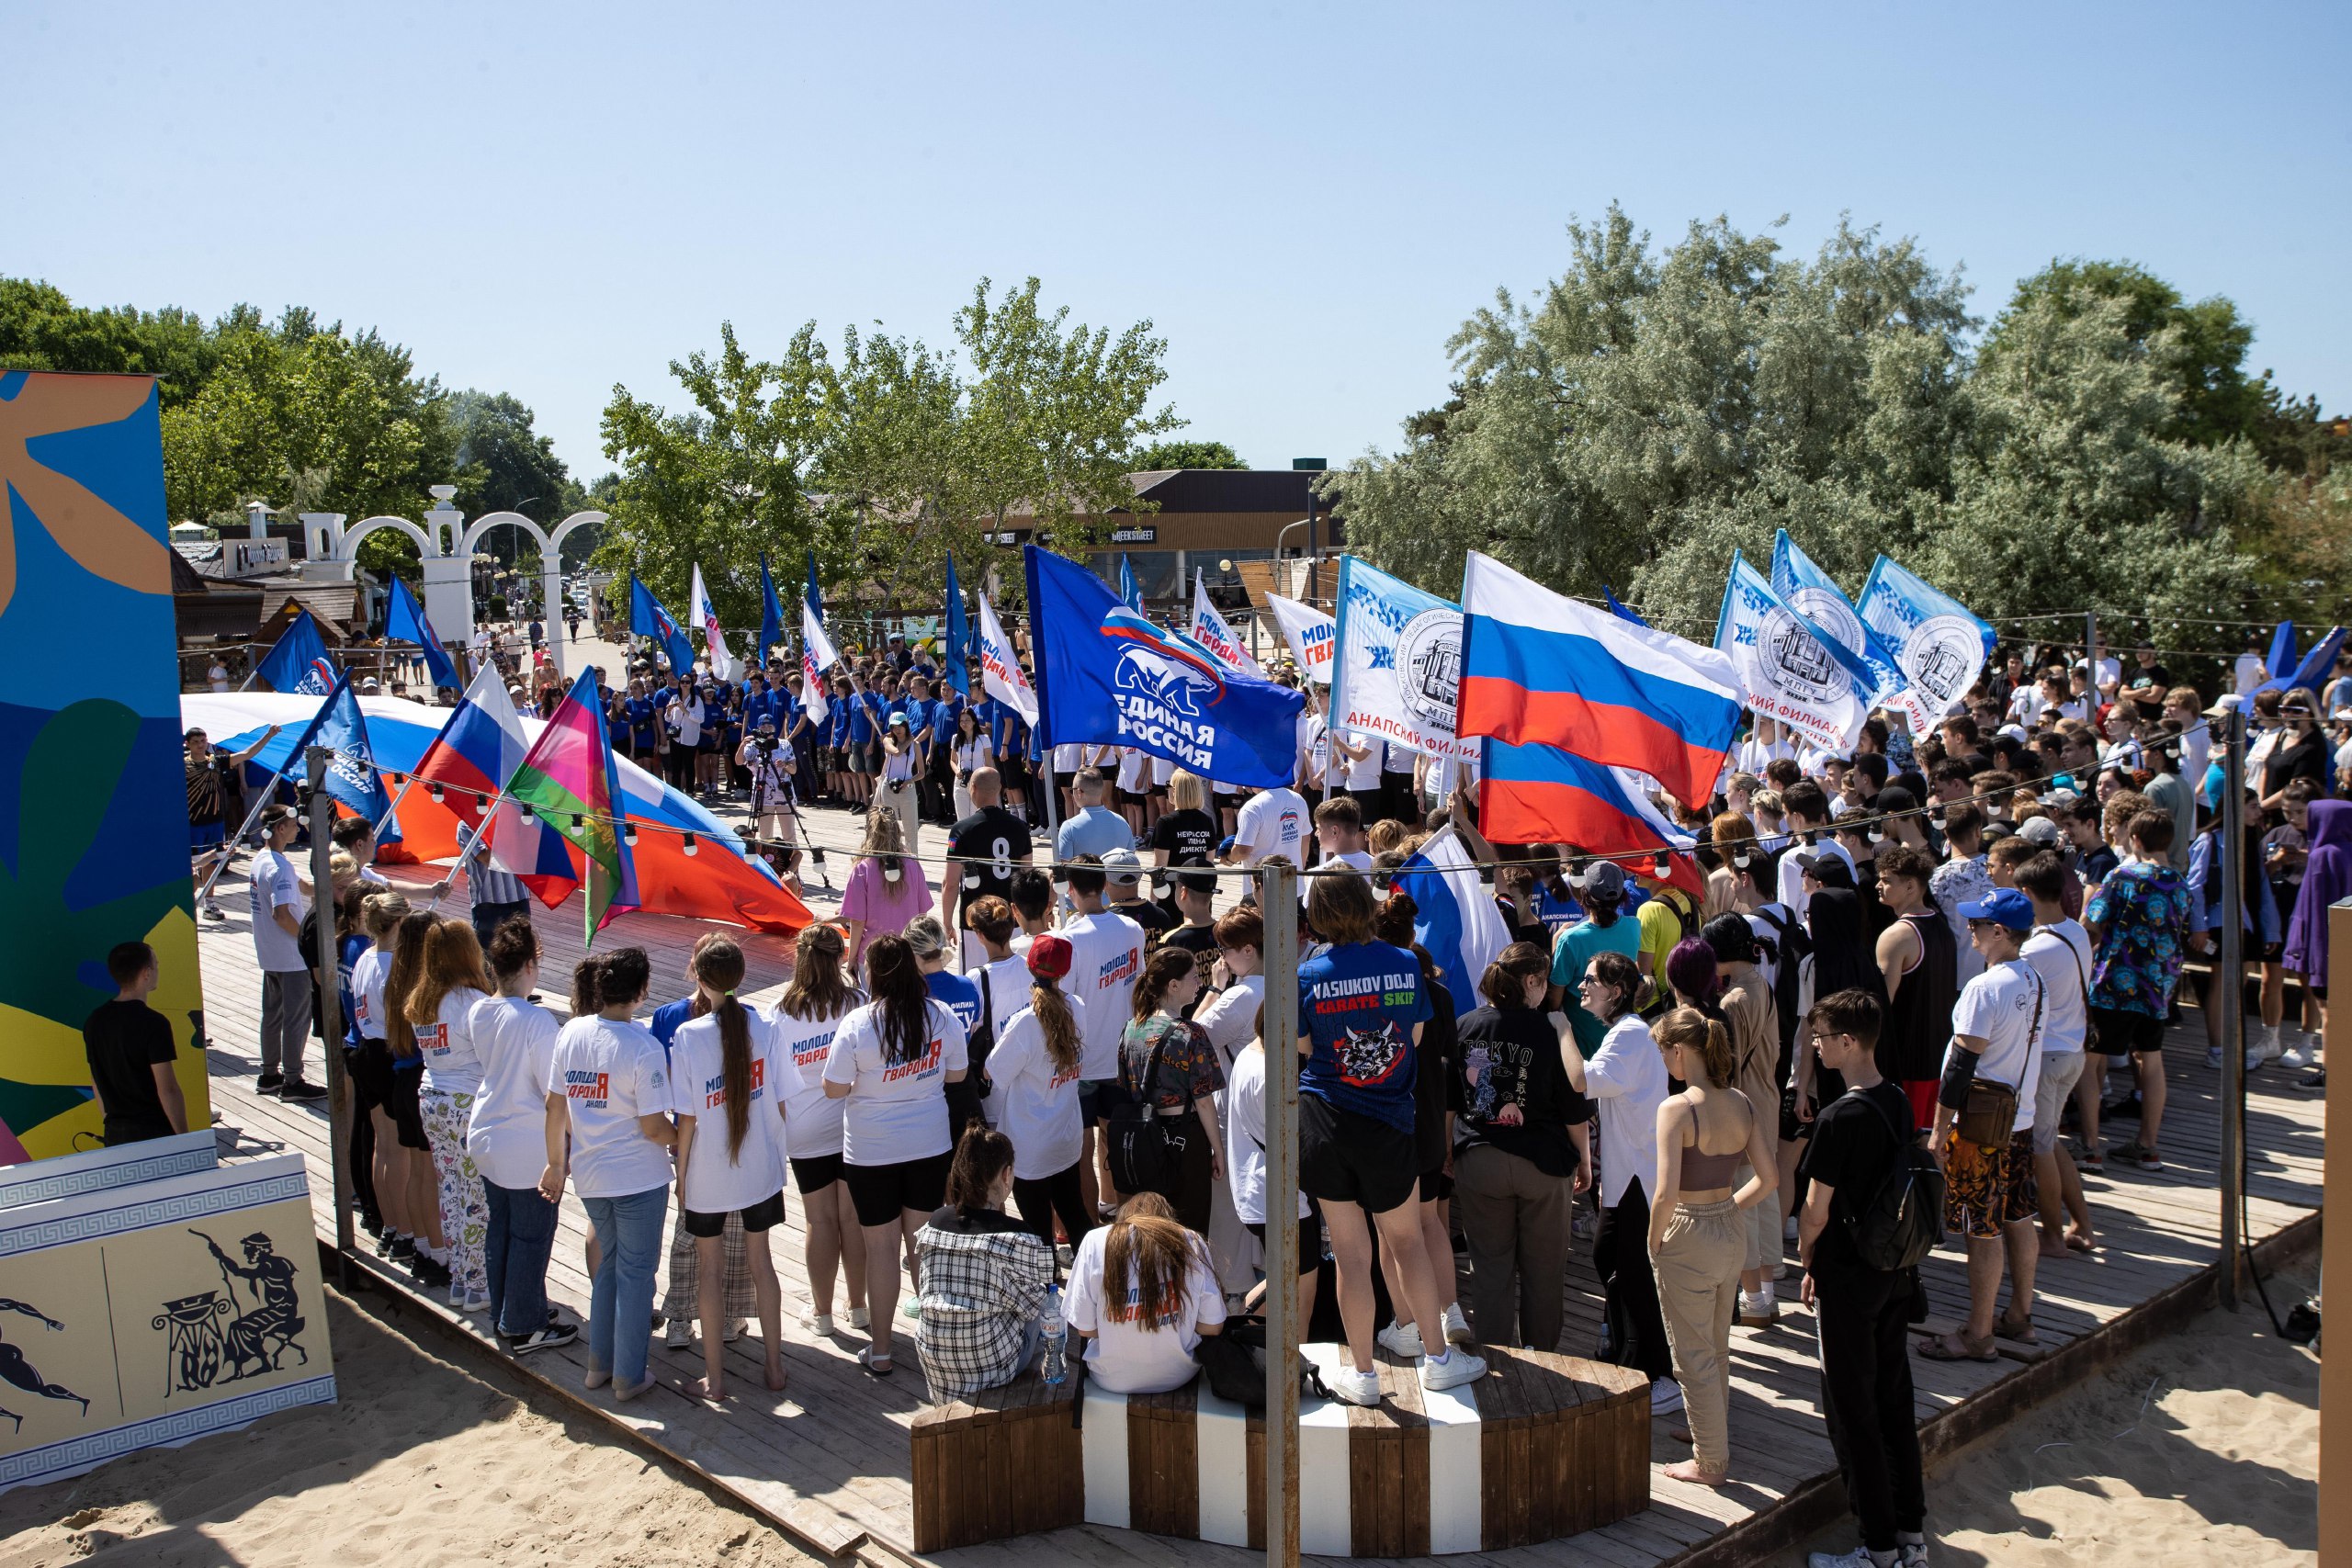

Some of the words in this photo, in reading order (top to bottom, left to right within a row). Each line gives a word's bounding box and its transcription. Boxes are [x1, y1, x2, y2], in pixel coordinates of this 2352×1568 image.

[1783, 677, 1817, 695] МПГУ
[1113, 694, 1215, 747] ЕДИНАЯ
[1347, 711, 1422, 747] АНАПСКИЙ
[1117, 715, 1213, 770] РОССИЯ
[992, 837, 1012, 880] 8
[1313, 976, 1380, 999] VASIUKOV
[1384, 974, 1415, 990] DOJO
[1316, 994, 1380, 1014] KARATE
[1384, 992, 1415, 1006] SKIF
[1464, 1040, 1533, 1066] TOKYO
[585, 1100, 607, 1109] АНАПА
